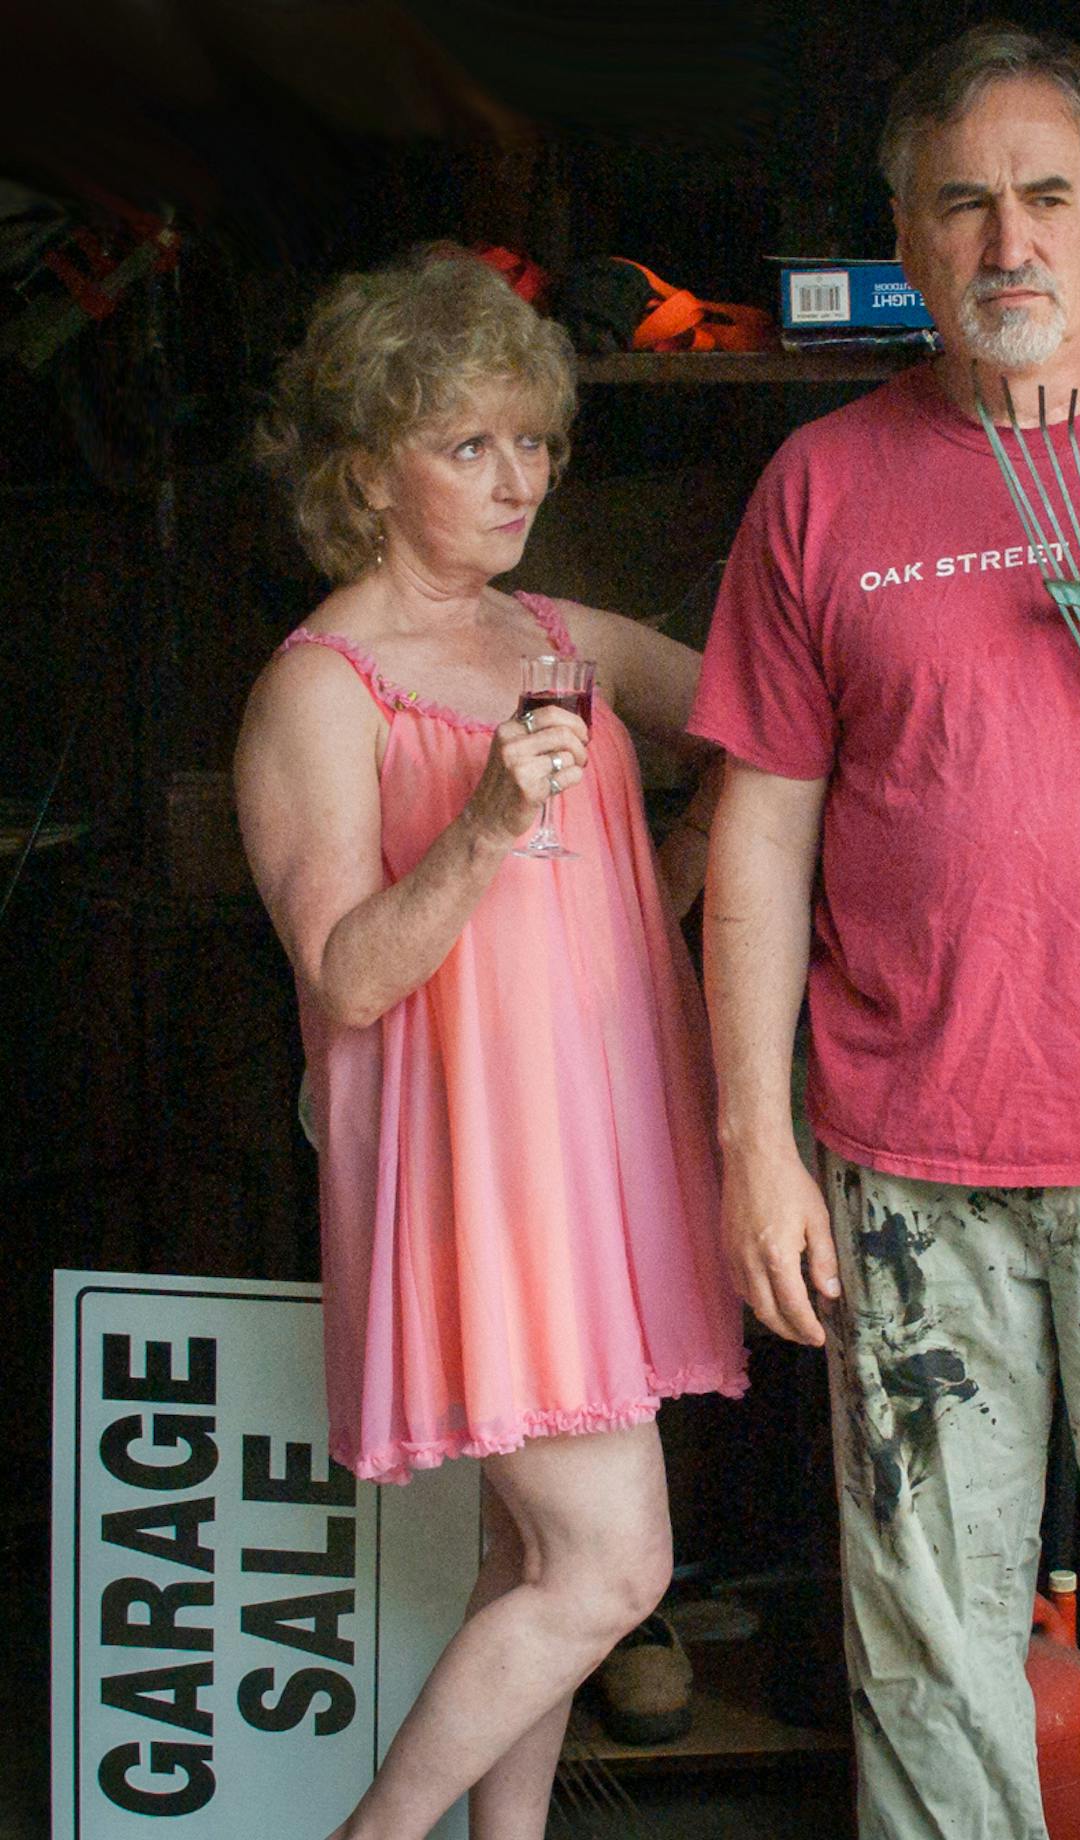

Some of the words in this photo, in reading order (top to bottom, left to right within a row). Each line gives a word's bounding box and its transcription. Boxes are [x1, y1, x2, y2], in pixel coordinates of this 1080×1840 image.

[872, 293, 916, 308] LIGHT
[875, 283, 911, 292] UTDOOR
[859, 561, 925, 592] OAK
[935, 541, 1069, 578] STREET
[97, 1333, 219, 1817] GARAGE
[237, 1434, 357, 1736] SALE
